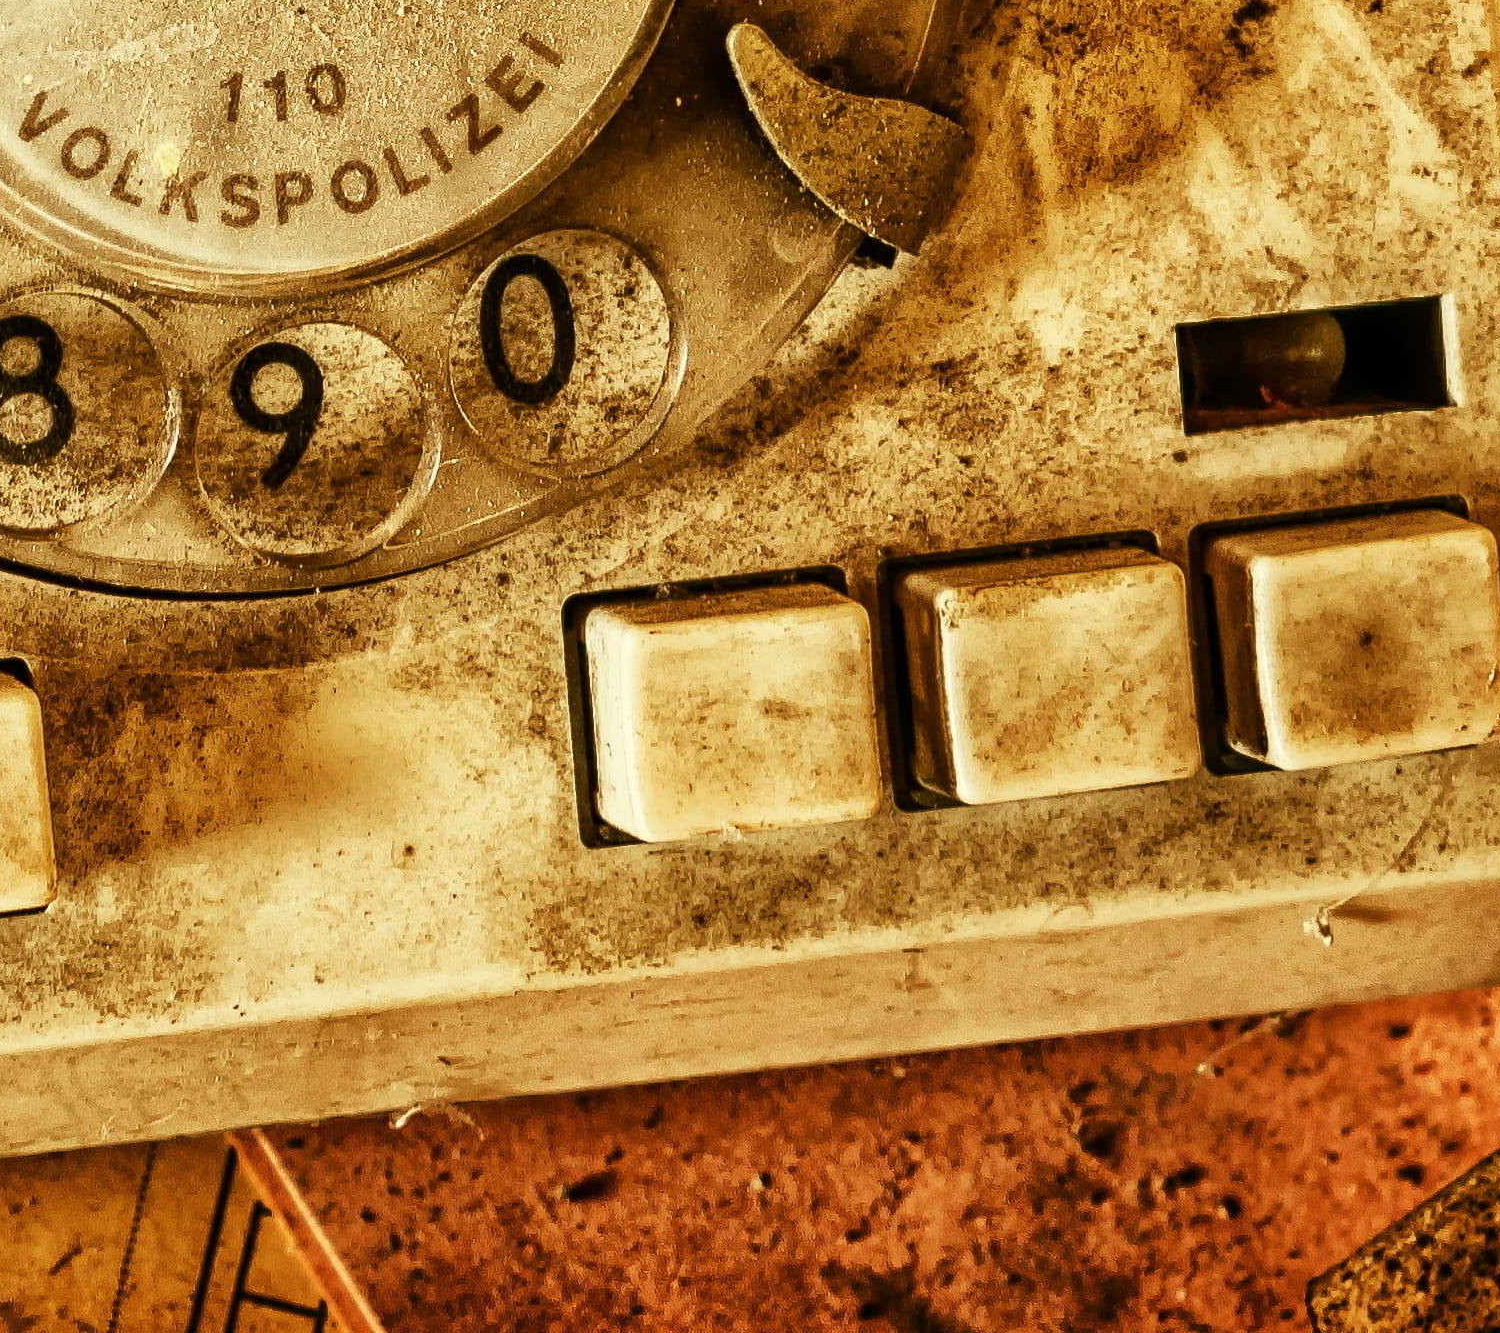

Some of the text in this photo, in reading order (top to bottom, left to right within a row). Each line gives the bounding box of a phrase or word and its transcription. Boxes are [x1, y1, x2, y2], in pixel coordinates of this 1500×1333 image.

[17, 33, 564, 228] VOLKSPOLIZEI
[220, 61, 348, 124] 110
[479, 253, 577, 406] 0
[230, 340, 326, 491] 9
